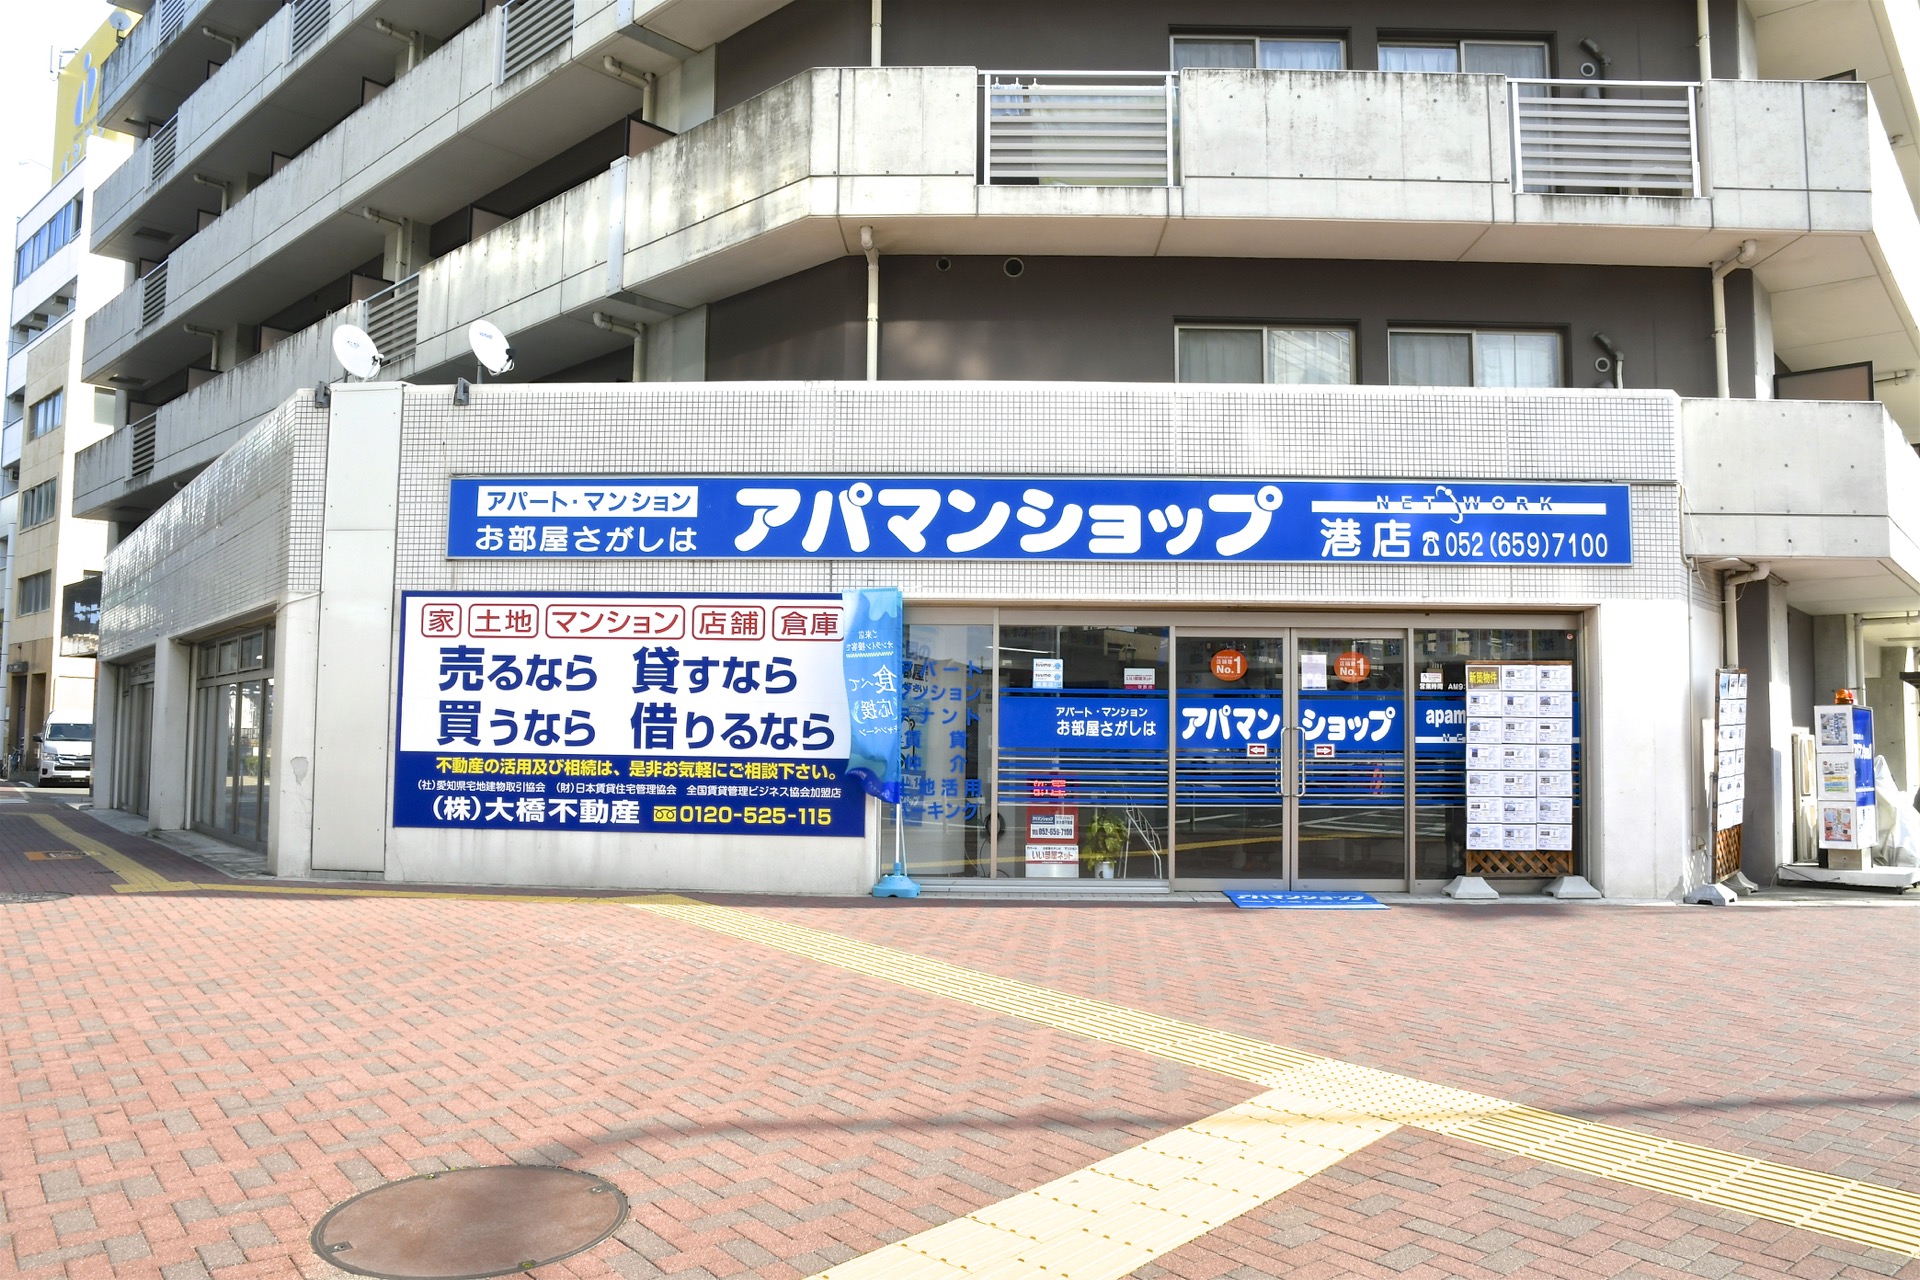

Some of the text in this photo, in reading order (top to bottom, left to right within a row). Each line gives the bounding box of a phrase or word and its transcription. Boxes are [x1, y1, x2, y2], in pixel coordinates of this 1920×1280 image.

[486, 491, 693, 514] アパート・マンション
[734, 482, 1283, 557] アパマンショップ
[475, 524, 698, 553] お部屋さがしは
[1320, 517, 1609, 559] 港店 052(659)7100
[428, 609, 839, 637] 家 土地 マンション 店舗 倉庫
[437, 645, 798, 695] 売るなら 貸すなら
[1216, 655, 1241, 674] No.1
[1339, 657, 1364, 676] No.1
[1468, 671, 1498, 684] 新築物件
[1055, 706, 1149, 718] アパート・マンション
[437, 700, 836, 750] 買うなら 借りるなら
[1056, 720, 1157, 738] お部屋さがしは
[435, 756, 836, 781] 不動産の活用及び相続は、是非お気軽にご相談下さい。
[686, 784, 842, 799] 全国賃貸管理ビジネス協会加盟店
[432, 795, 833, 826] (株)大橋不動産 0120-525-115
